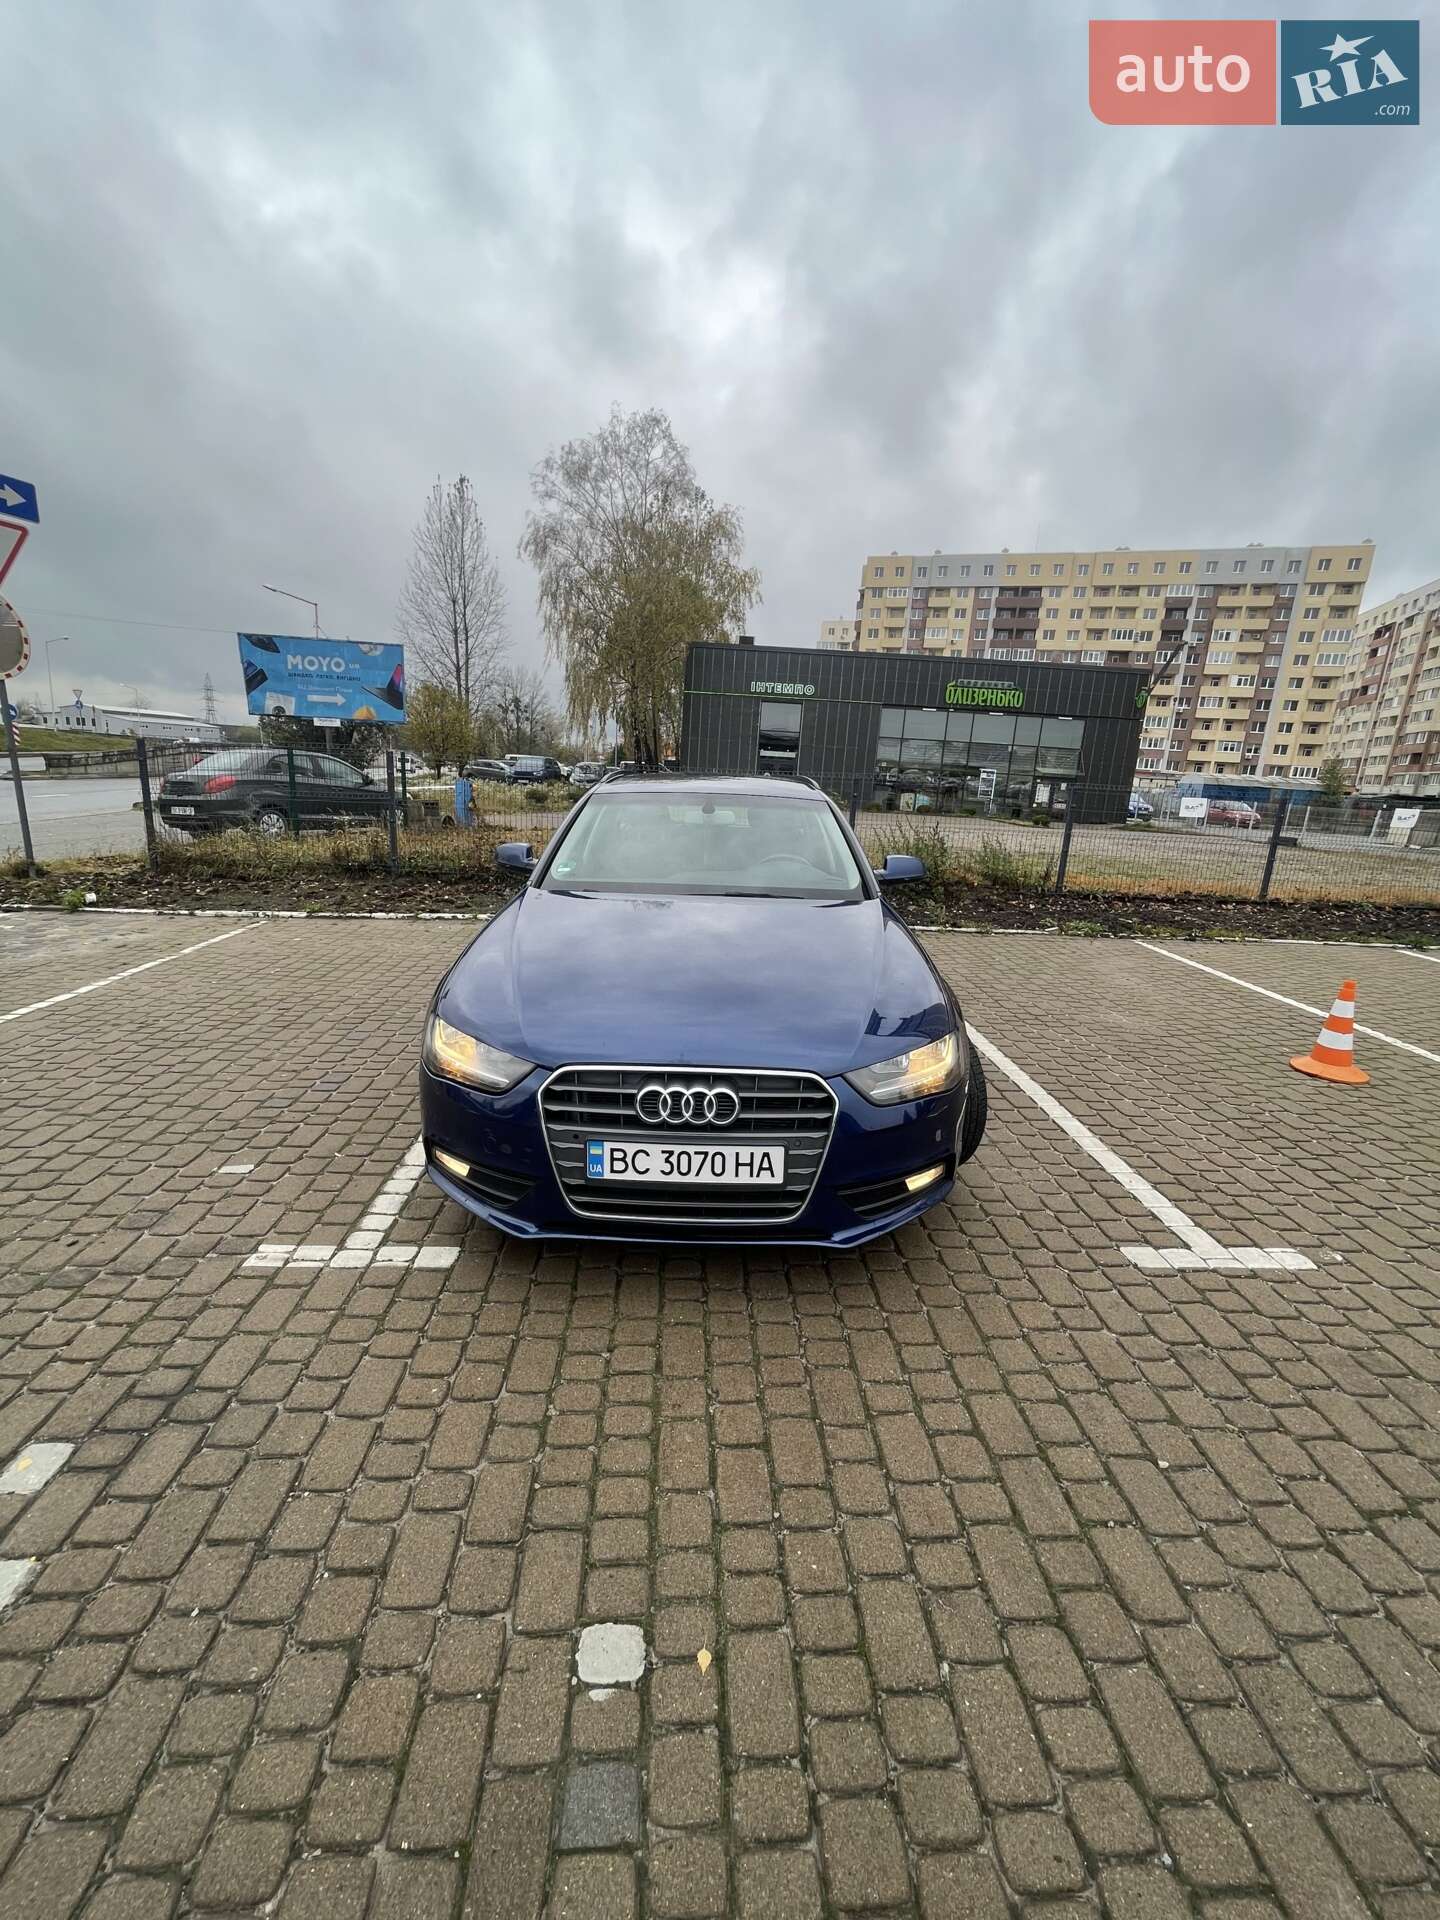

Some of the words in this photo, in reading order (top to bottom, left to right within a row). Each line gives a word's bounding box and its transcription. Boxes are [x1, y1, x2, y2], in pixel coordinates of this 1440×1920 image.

[287, 654, 345, 672] MOYO
[751, 681, 815, 696] ІНТЕМПО
[589, 1164, 603, 1173] UA
[610, 1148, 650, 1175] BC
[660, 1150, 726, 1177] 3070
[734, 1151, 776, 1178] HA
